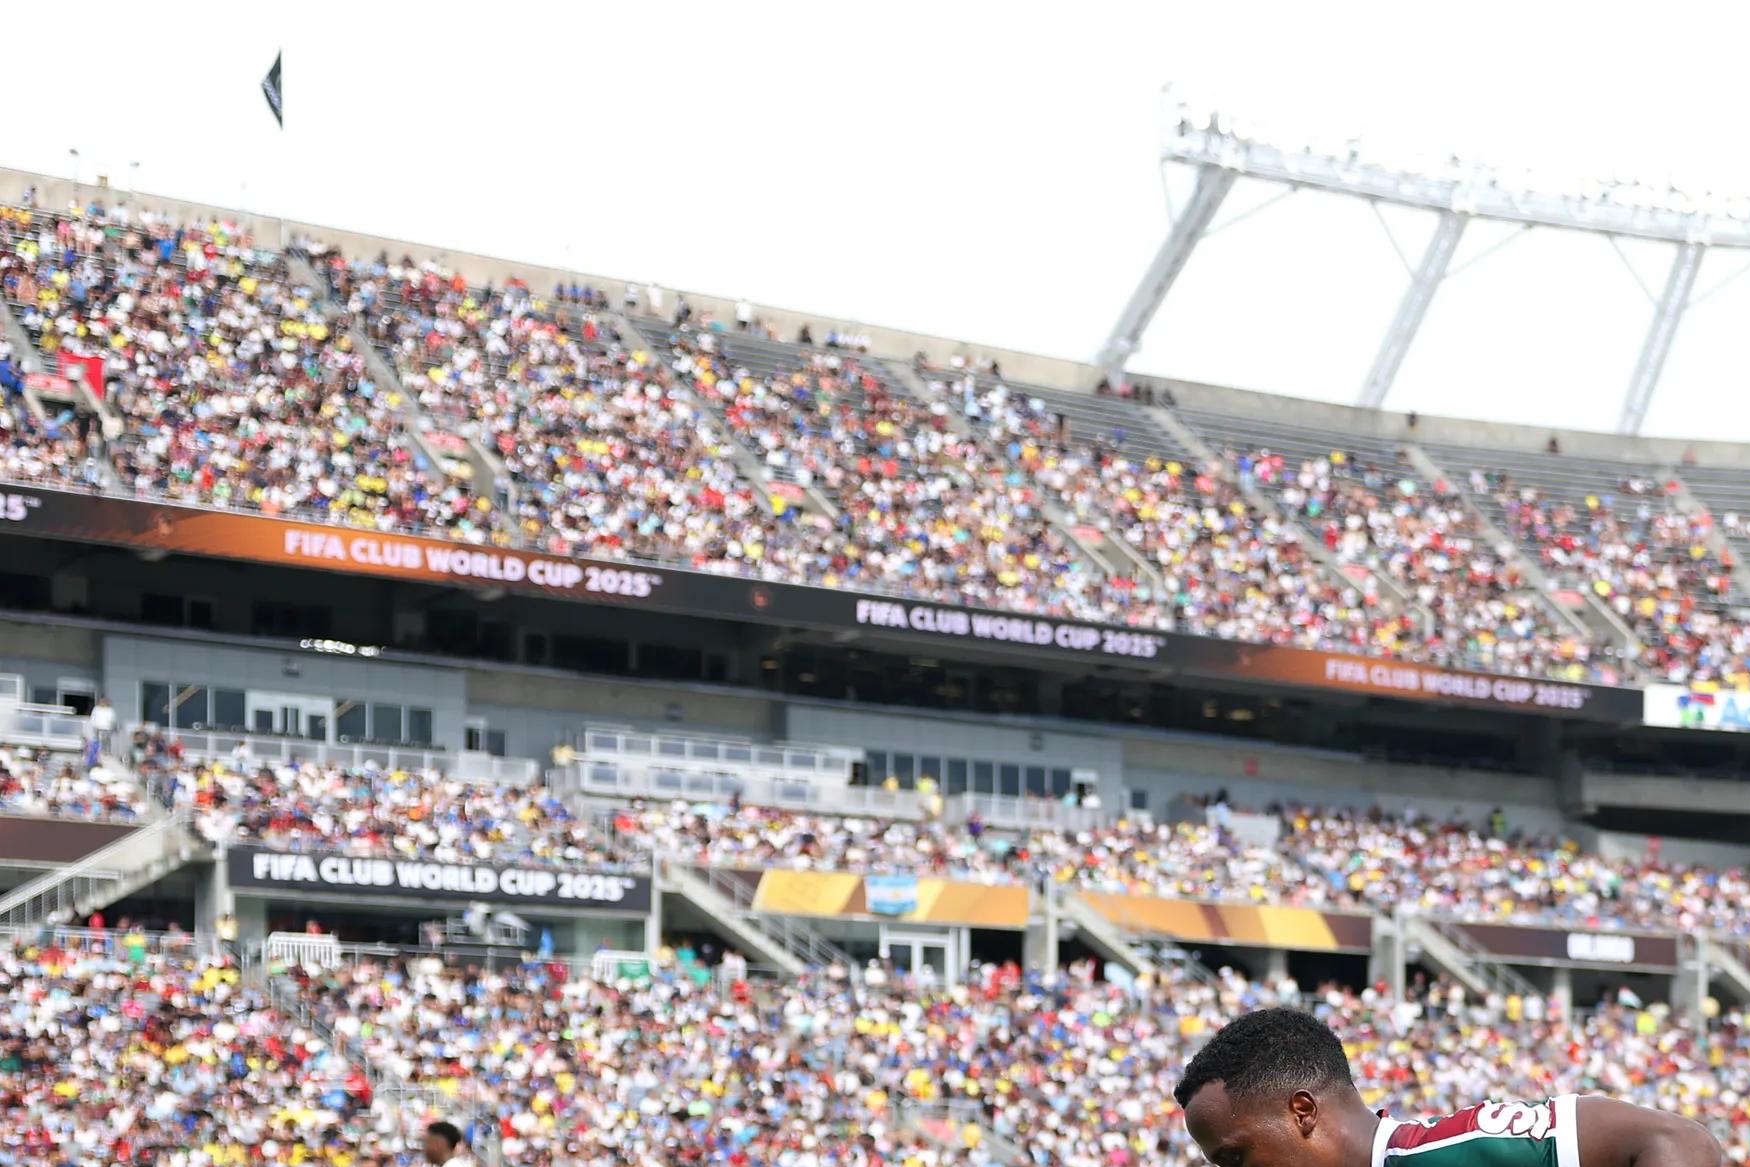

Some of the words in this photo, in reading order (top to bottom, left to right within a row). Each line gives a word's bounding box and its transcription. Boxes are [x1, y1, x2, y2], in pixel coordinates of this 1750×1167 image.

[284, 528, 345, 561] FIFA
[349, 537, 423, 568] CLUB
[426, 546, 526, 582] WORLD
[527, 561, 582, 588] CUP
[856, 600, 909, 628] FIFA
[909, 606, 970, 635] CLUB
[971, 613, 1052, 645] WORLD
[1054, 624, 1100, 650] CUP
[1325, 659, 1368, 684] FIFA
[1369, 664, 1420, 690] CLUB
[1421, 672, 1492, 699] WORLD
[1493, 678, 1533, 703] CUP
[252, 852, 319, 883] FIFA
[319, 856, 394, 887] CLUB
[395, 862, 498, 894] WORLD
[499, 868, 556, 897] CUP
